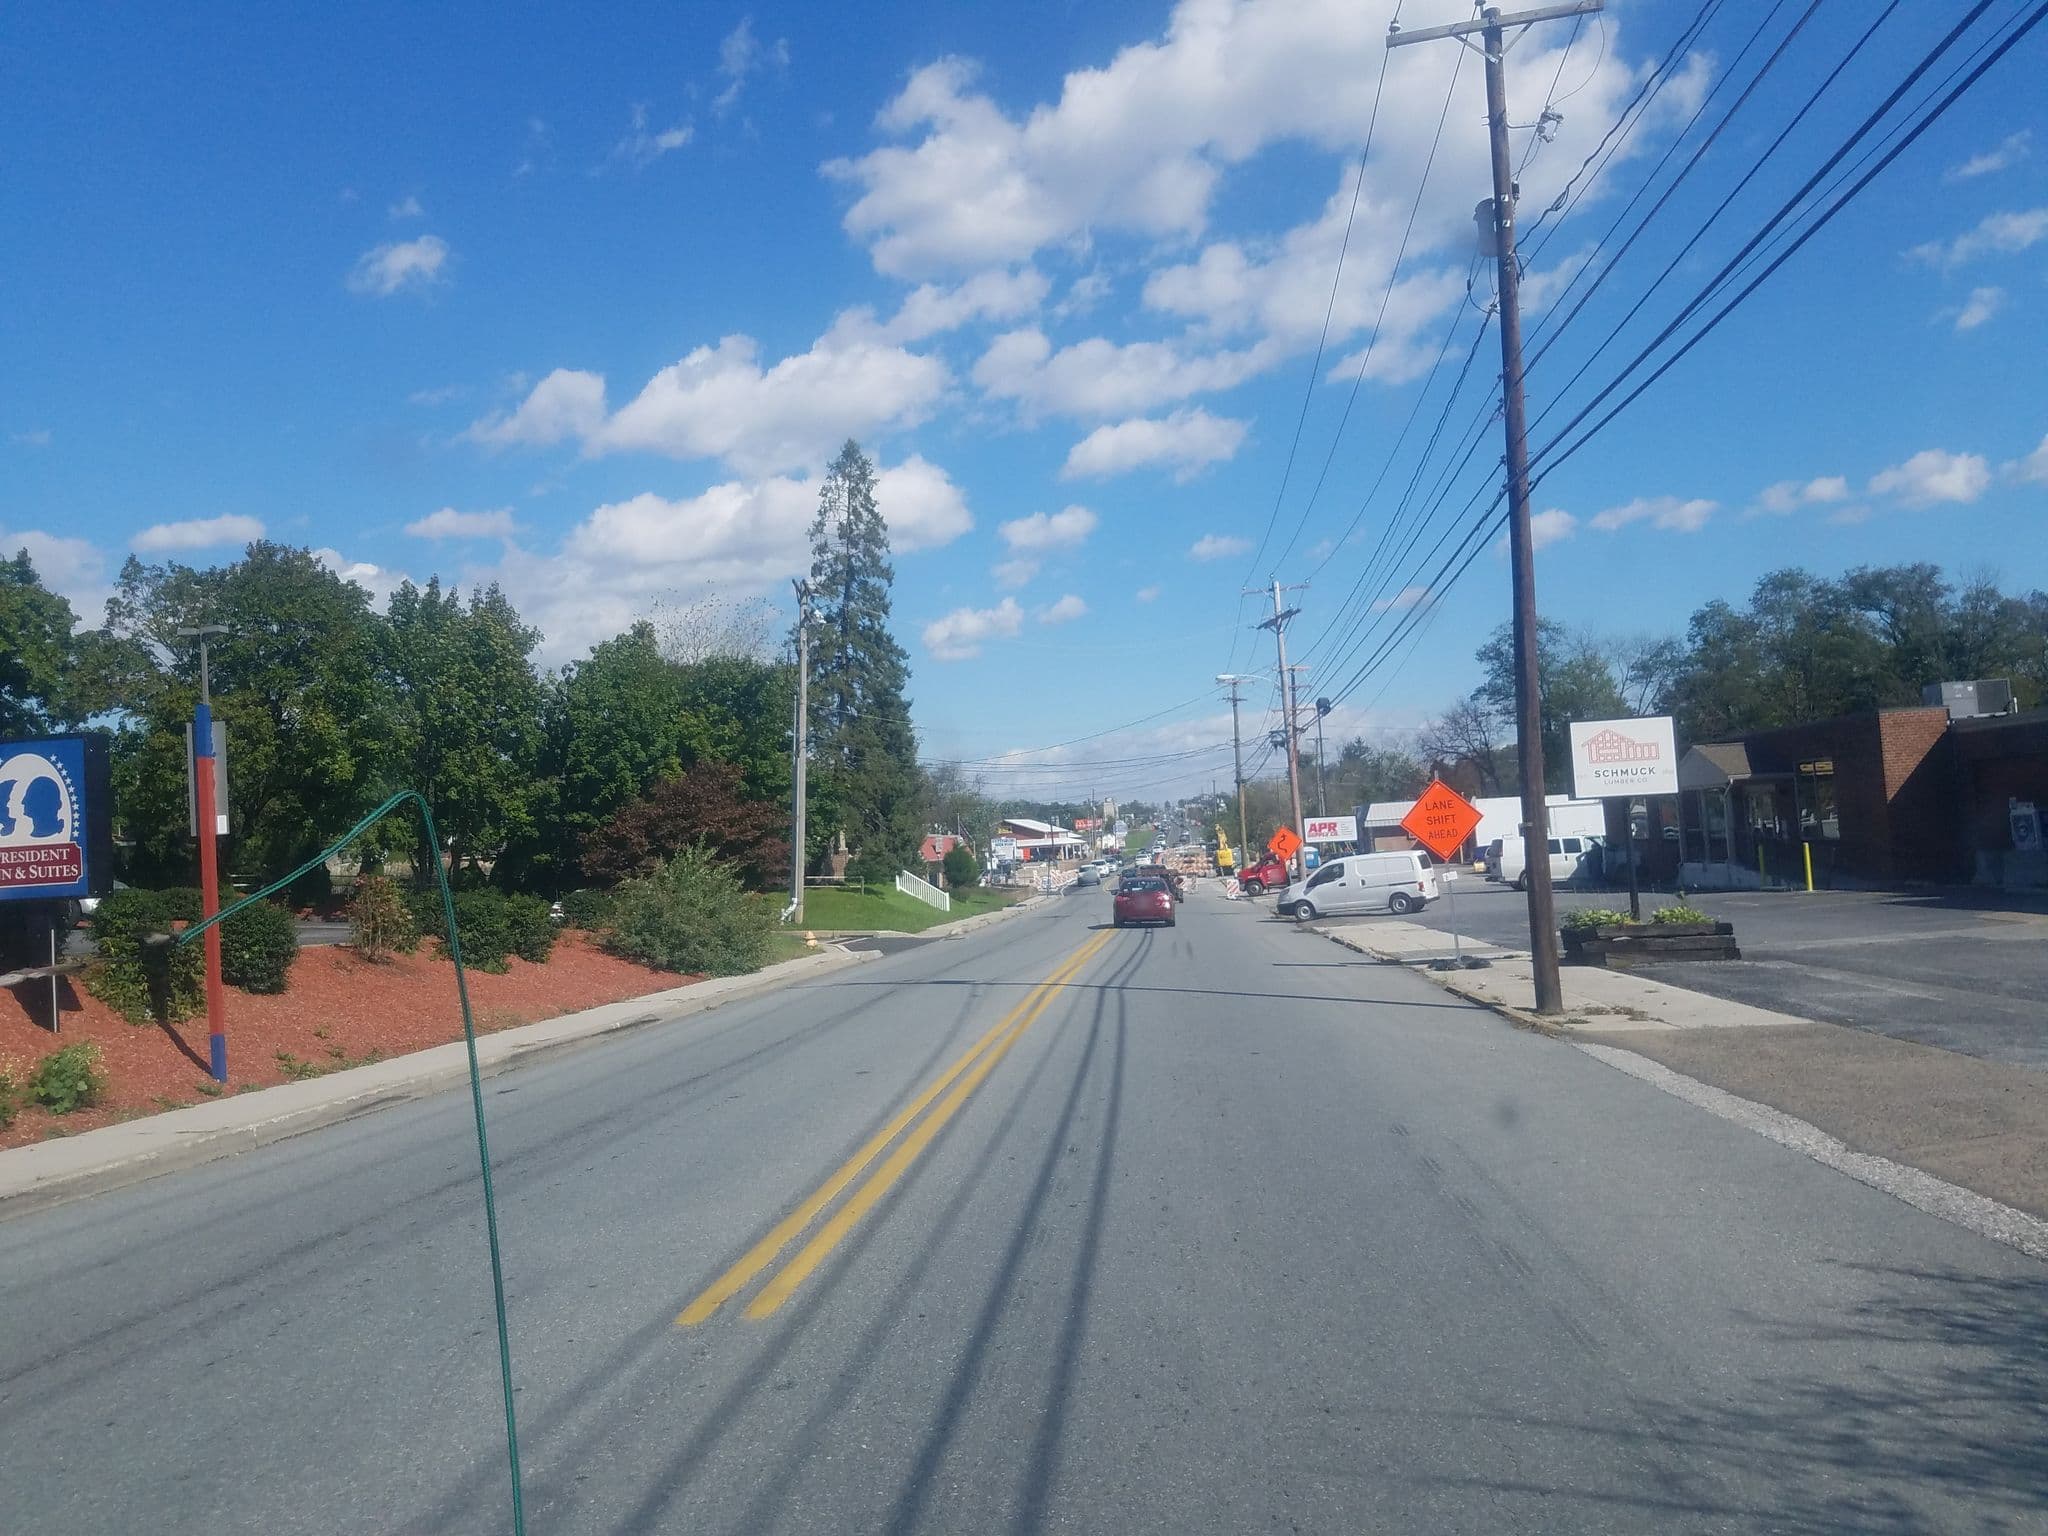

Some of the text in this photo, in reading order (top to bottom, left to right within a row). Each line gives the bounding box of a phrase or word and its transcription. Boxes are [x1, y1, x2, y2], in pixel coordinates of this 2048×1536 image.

[1594, 767, 1656, 778] SCHMUCK
[1425, 800, 1454, 811] LANE
[1426, 814, 1456, 826] SHIFT
[1308, 822, 1338, 833] APR
[1428, 828, 1459, 840] AHEAD
[0, 848, 70, 864] RESIDENT
[15, 866, 26, 879] &
[29, 864, 79, 879] SUITES
